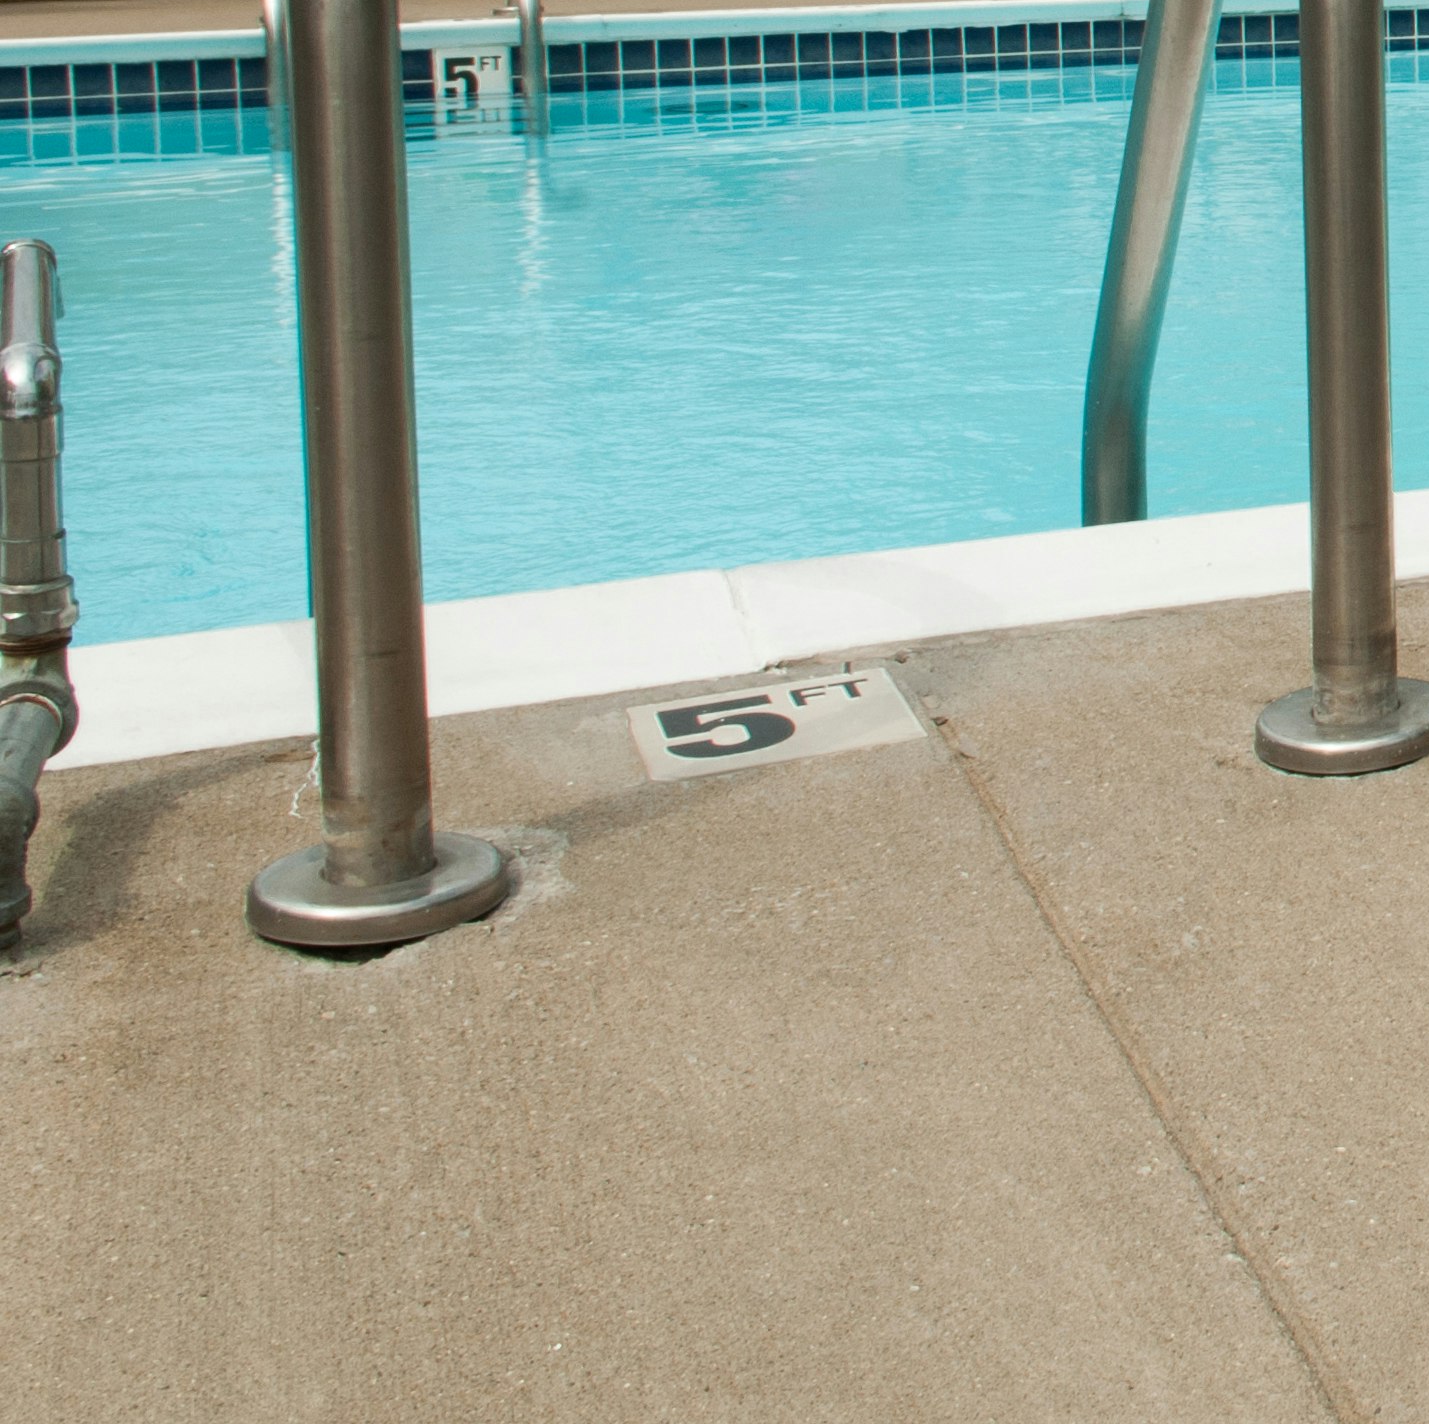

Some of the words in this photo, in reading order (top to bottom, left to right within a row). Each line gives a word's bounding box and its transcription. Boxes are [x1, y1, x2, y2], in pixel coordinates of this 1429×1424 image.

[444, 57, 480, 105] 5
[479, 55, 502, 72] FT
[656, 694, 796, 759] 5
[787, 677, 869, 708] FT
